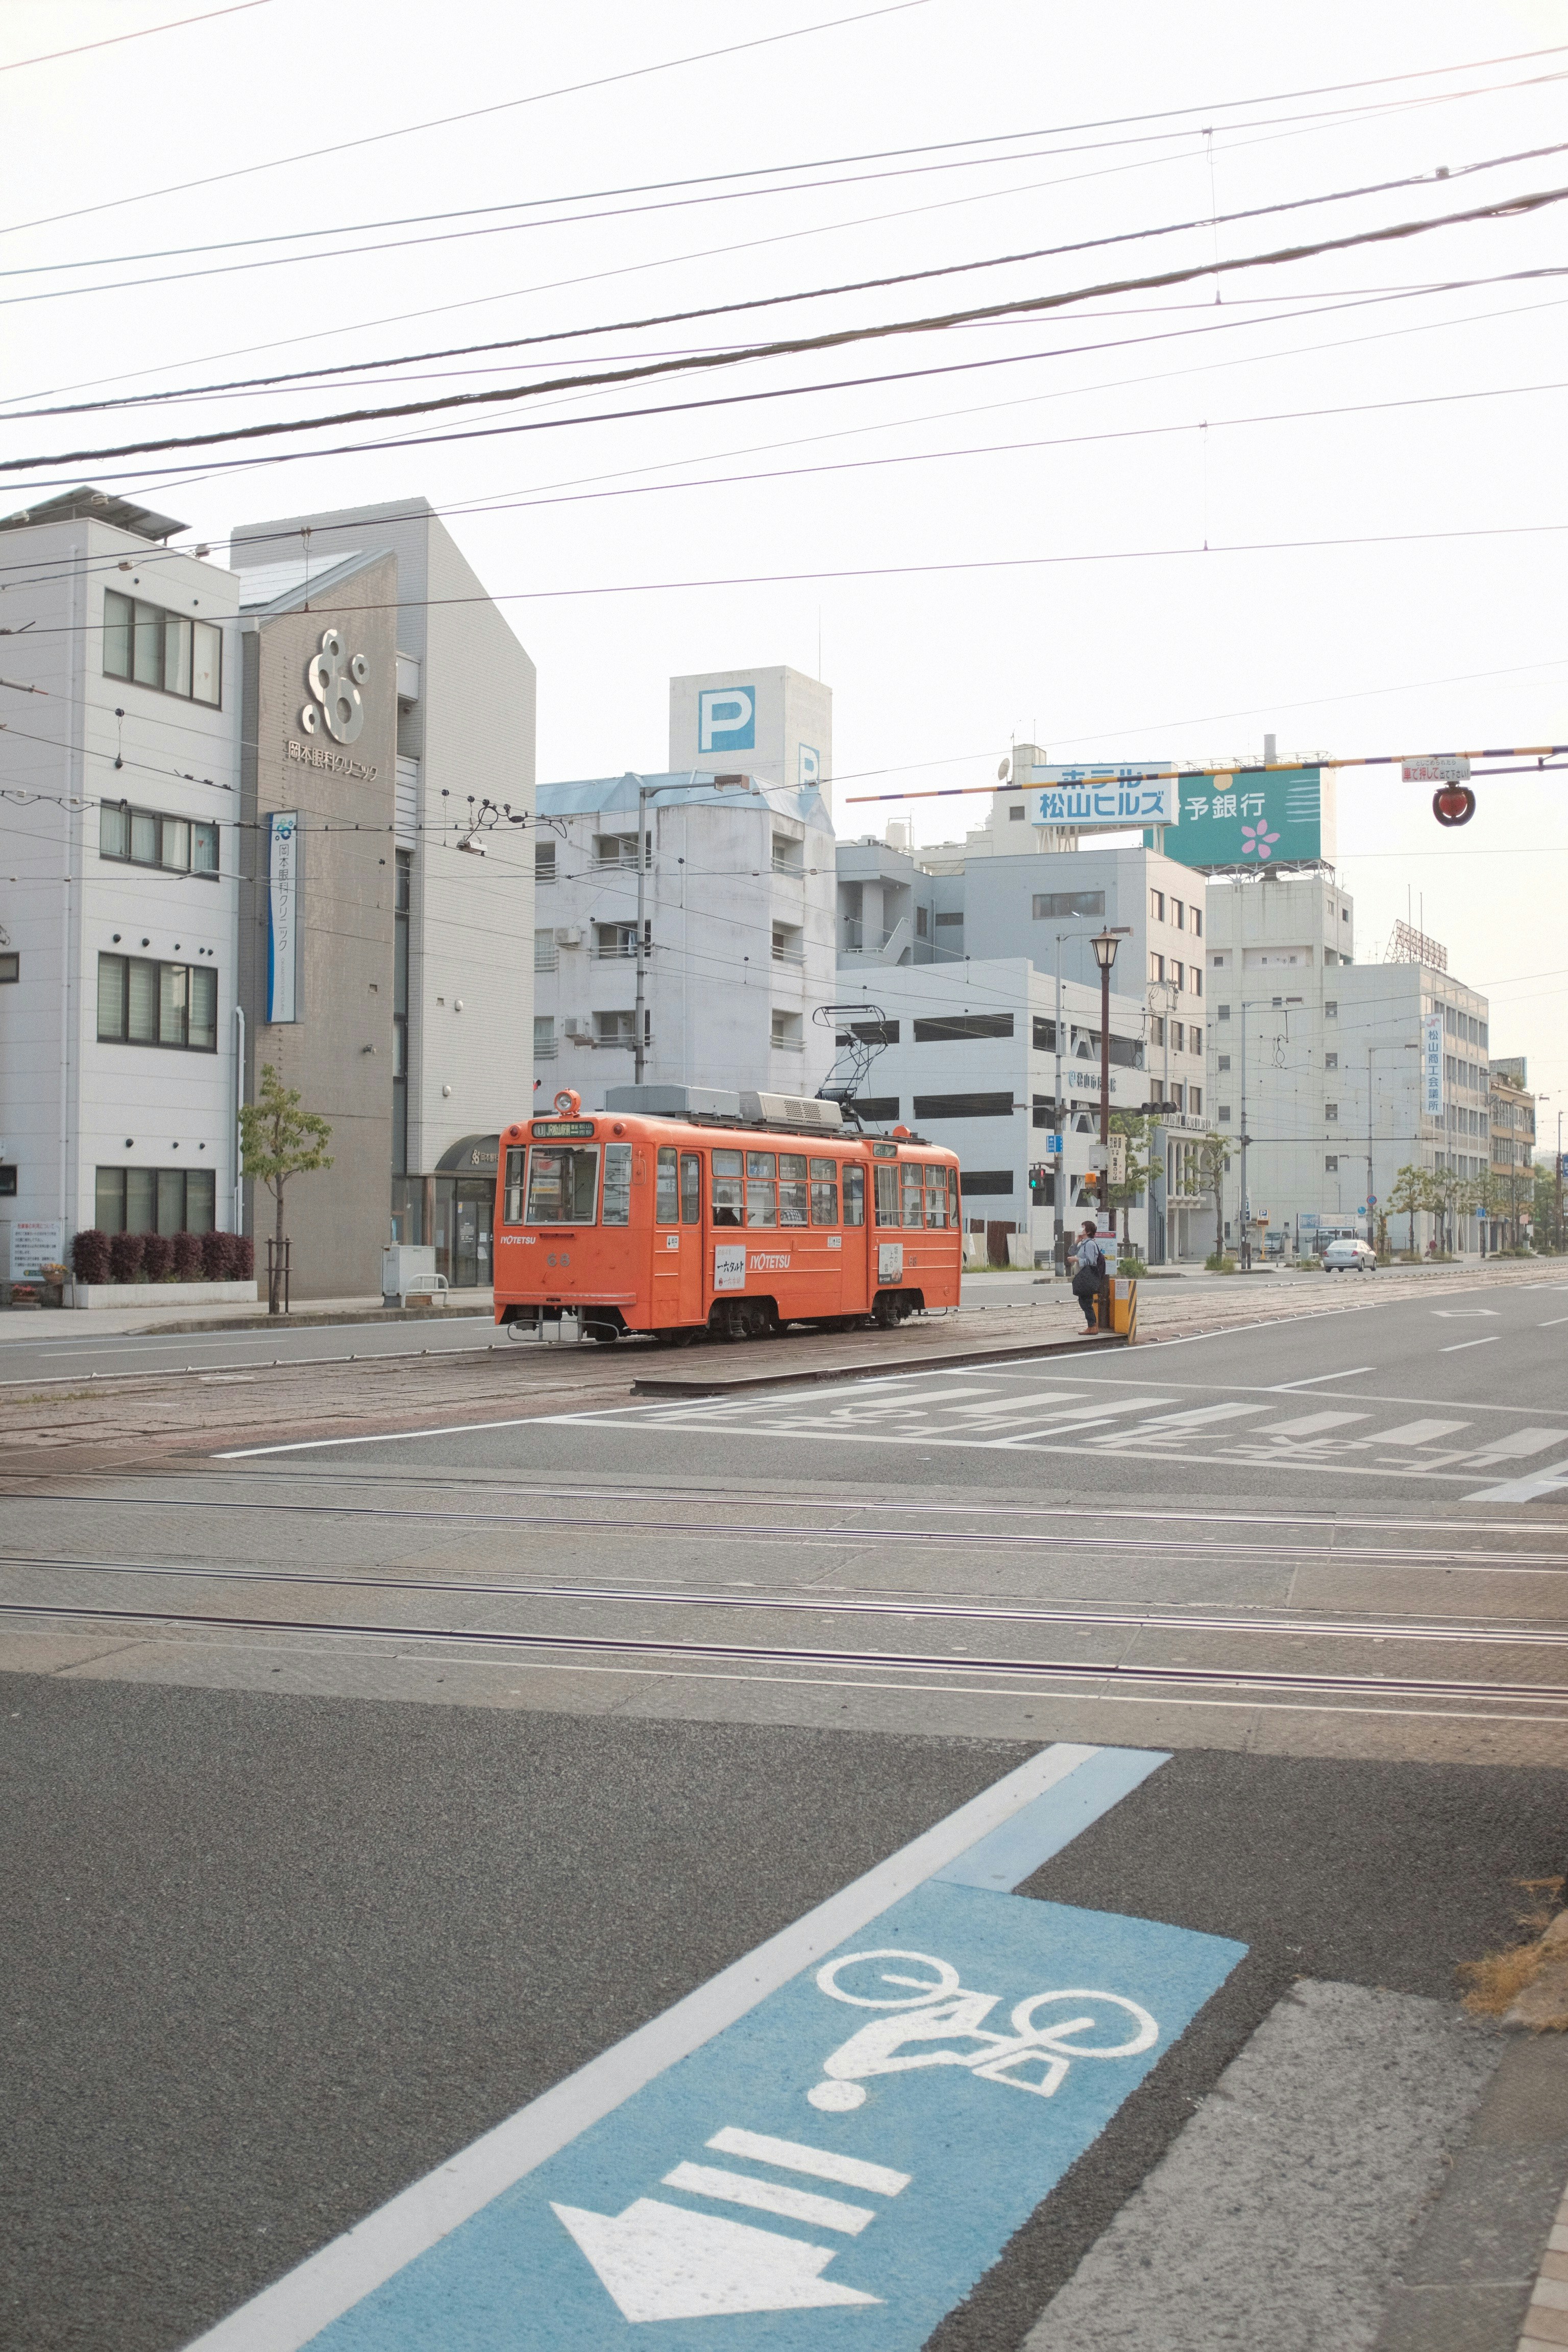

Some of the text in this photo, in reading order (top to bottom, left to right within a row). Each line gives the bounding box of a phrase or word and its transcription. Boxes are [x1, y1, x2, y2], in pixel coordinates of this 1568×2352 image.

[701, 691, 752, 750] P
[288, 741, 378, 781] 岡本眼科クリニック
[1062, 769, 1142, 790] ホテル
[1040, 791, 1164, 818] 松山ヒルズ
[1179, 793, 1265, 820] 予銀行
[279, 844, 289, 951] 岡本眼科クリニック
[1428, 1030, 1439, 1111] 松山商工会議所
[500, 1236, 536, 1244] IYOTETSU
[547, 1253, 570, 1267] 68
[717, 1261, 744, 1272] 一六タルト
[750, 1253, 791, 1270] IYOTETSU
[909, 1256, 917, 1266] 68
